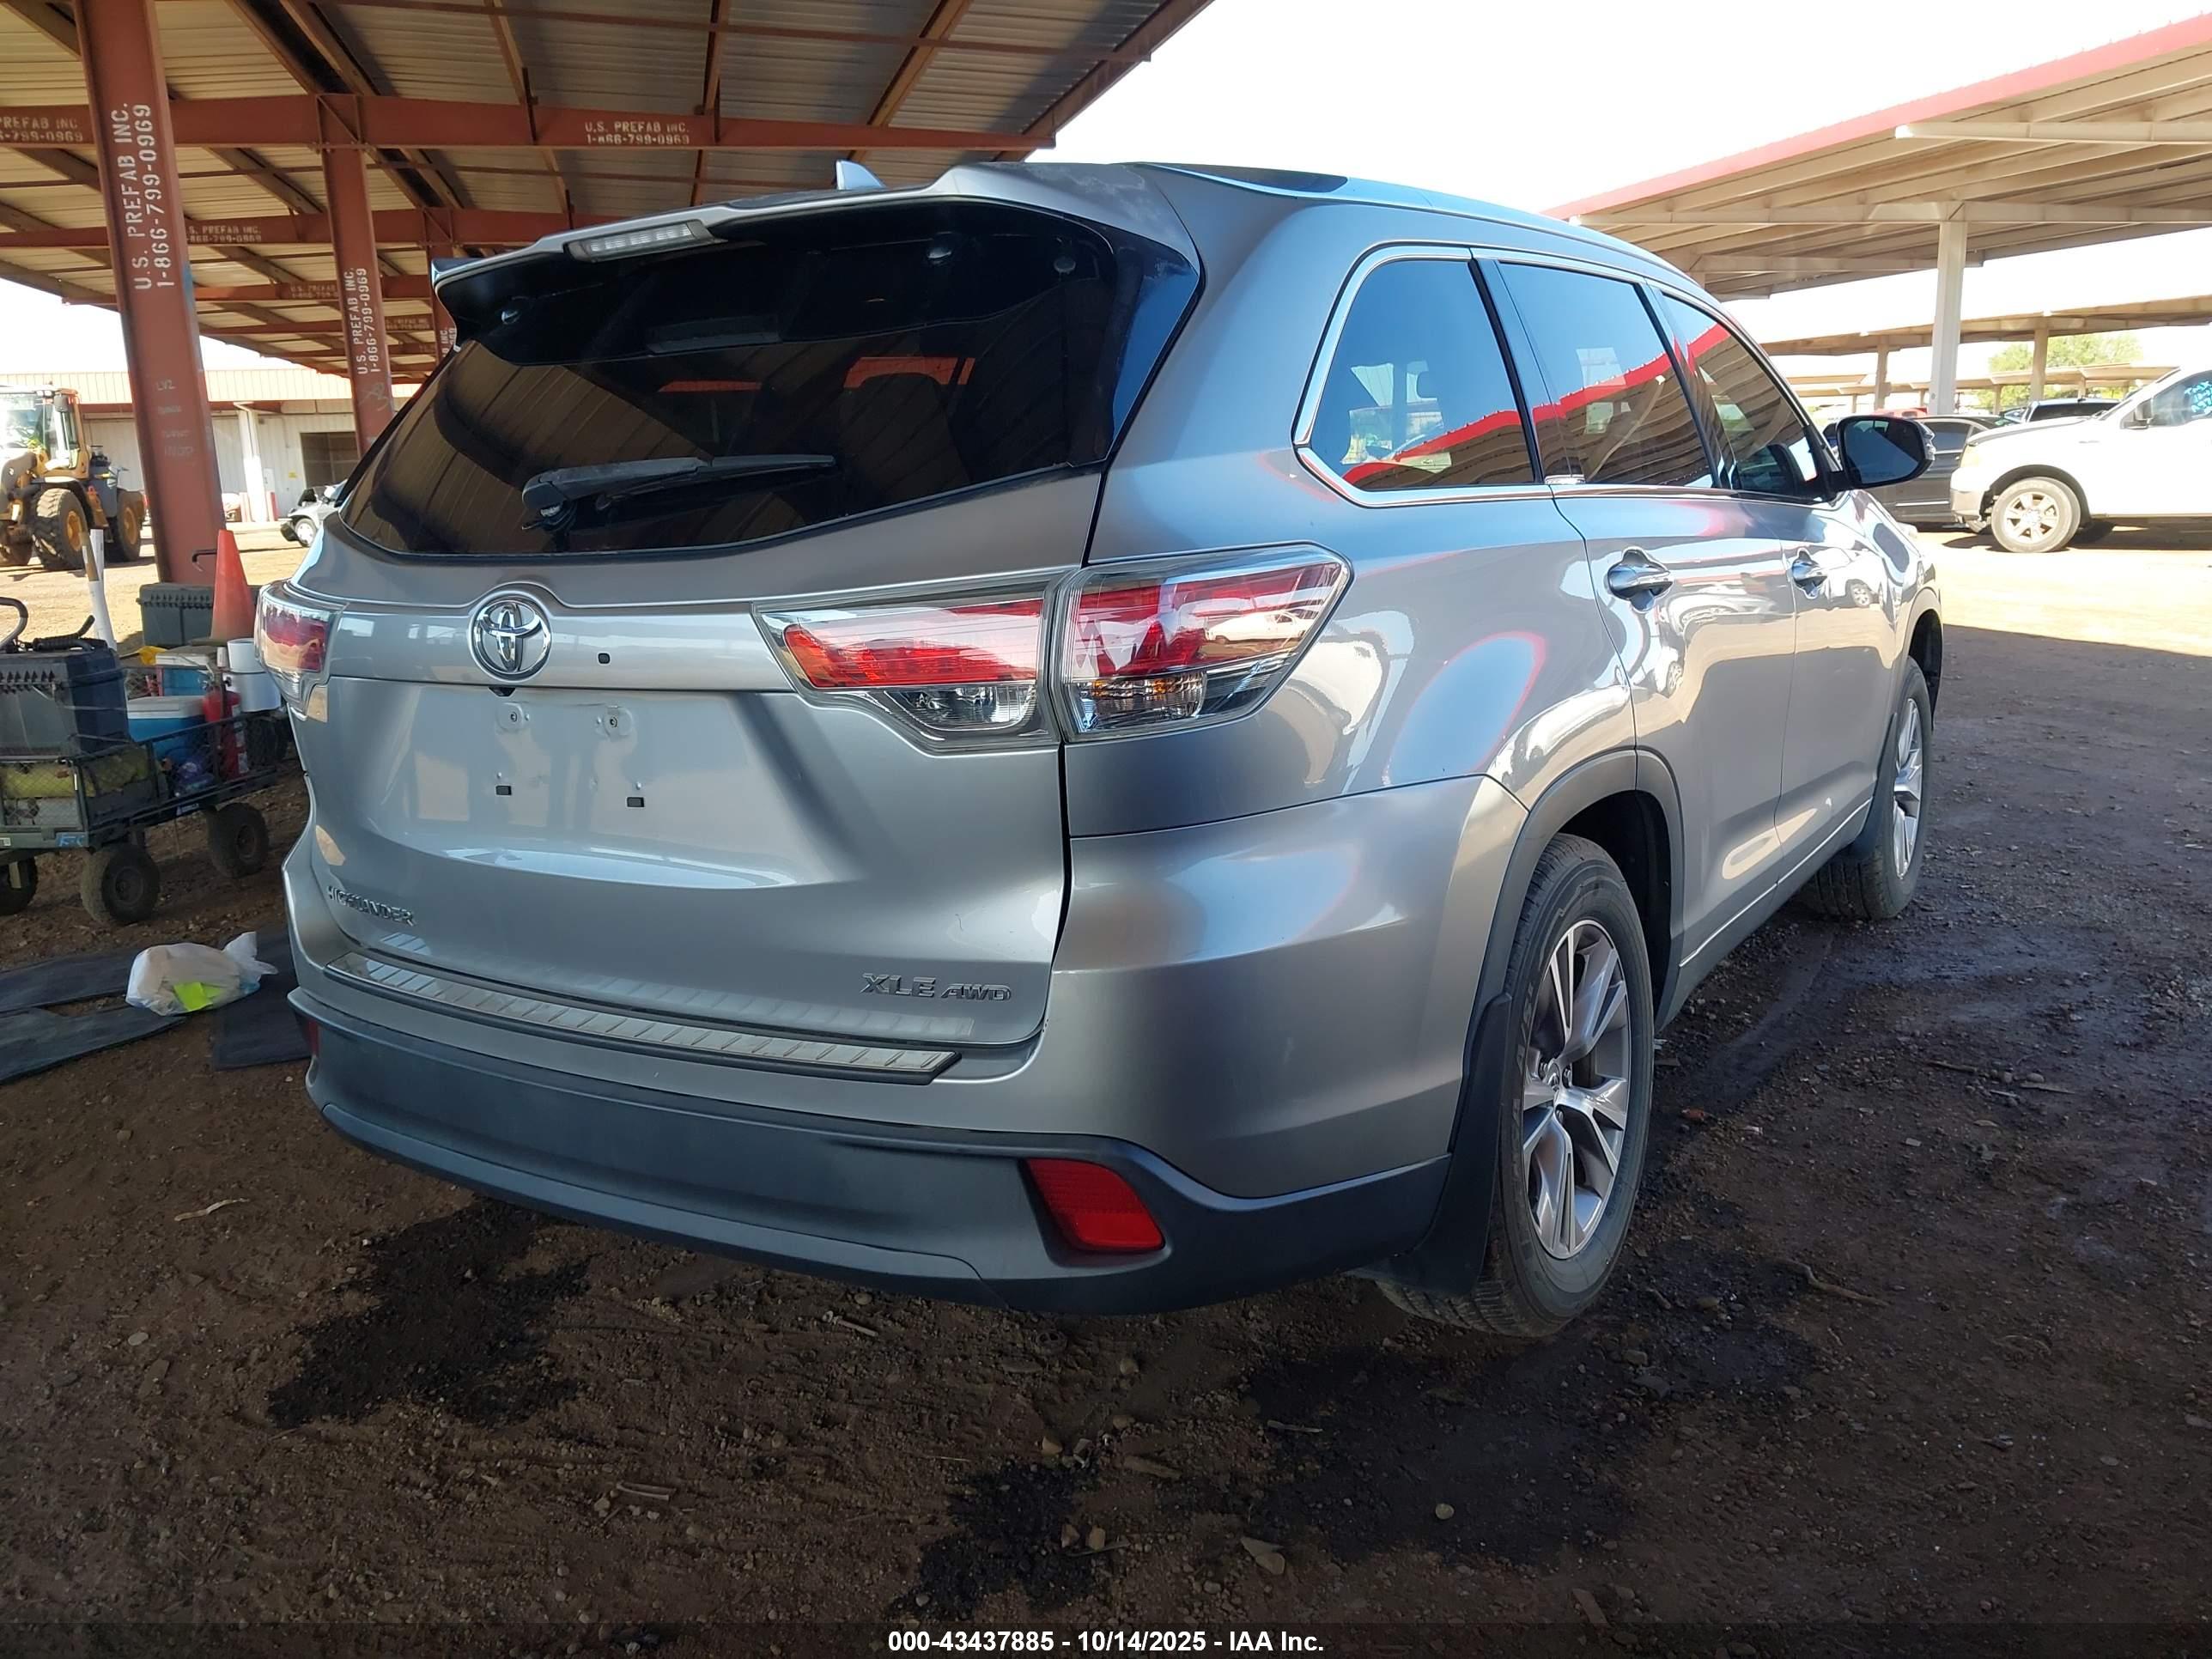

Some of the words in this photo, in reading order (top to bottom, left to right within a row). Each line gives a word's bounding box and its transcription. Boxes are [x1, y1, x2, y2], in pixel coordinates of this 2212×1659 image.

[111, 103, 133, 143] INC.
[585, 121, 608, 133] U.S.
[614, 121, 661, 133] PREFAB
[117, 155, 146, 237] PREFAB
[133, 104, 174, 288] 1-866-799-0969
[131, 250, 153, 289] U.S.
[344, 268, 357, 291] INC.
[347, 297, 364, 344] PREFAB
[356, 268, 381, 373] 1-866-799-0969
[356, 351, 368, 374] U.S.
[327, 885, 417, 927] HIGHLANDER
[860, 972, 936, 998] XLE
[940, 983, 1011, 1001] AWD
